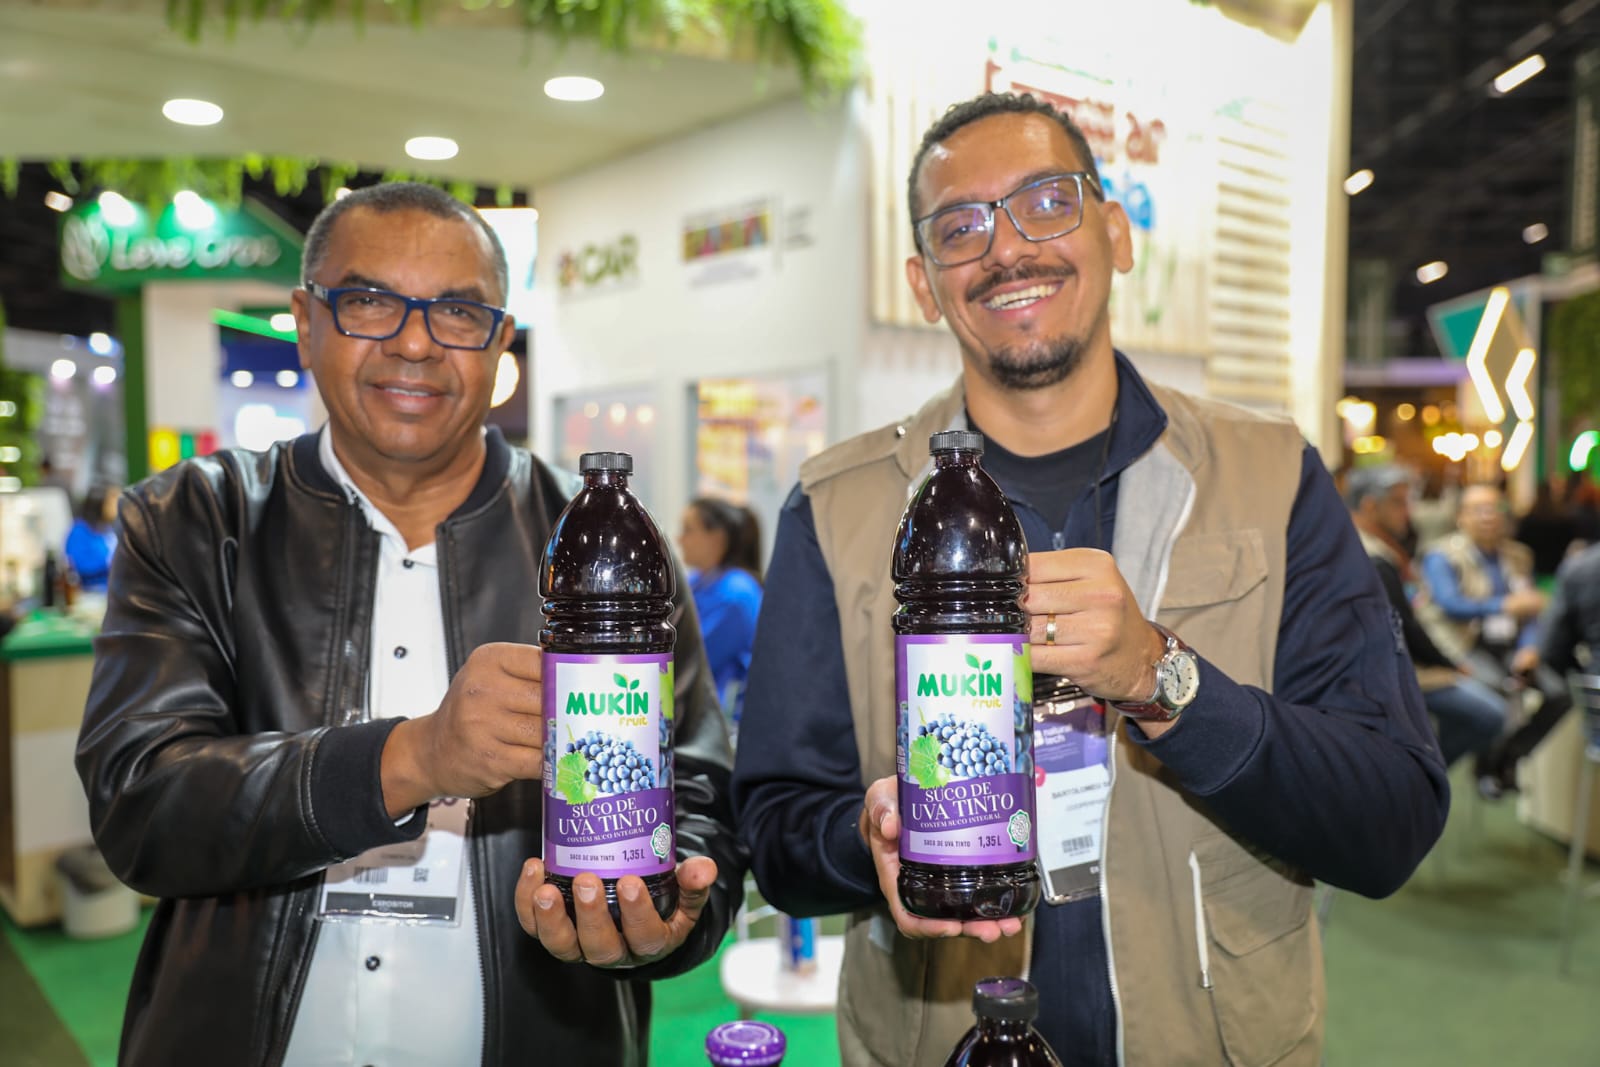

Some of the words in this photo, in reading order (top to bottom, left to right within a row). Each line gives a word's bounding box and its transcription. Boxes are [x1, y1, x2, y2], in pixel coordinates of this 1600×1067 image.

[917, 673, 1002, 697] MUKIN
[565, 691, 649, 715] MUKIN
[925, 786, 967, 803] SUCO
[970, 781, 992, 797] DE
[572, 801, 612, 818] SUCO
[616, 797, 637, 811] DE
[912, 803, 951, 821] UVA
[952, 792, 1014, 818] TINTO
[558, 818, 596, 835] UVA
[598, 807, 657, 833] TINTO
[948, 818, 967, 827] SUCO
[968, 812, 1001, 824] INTEGRAL
[594, 833, 613, 841] SUCO
[613, 826, 645, 839] INTEGRAL
